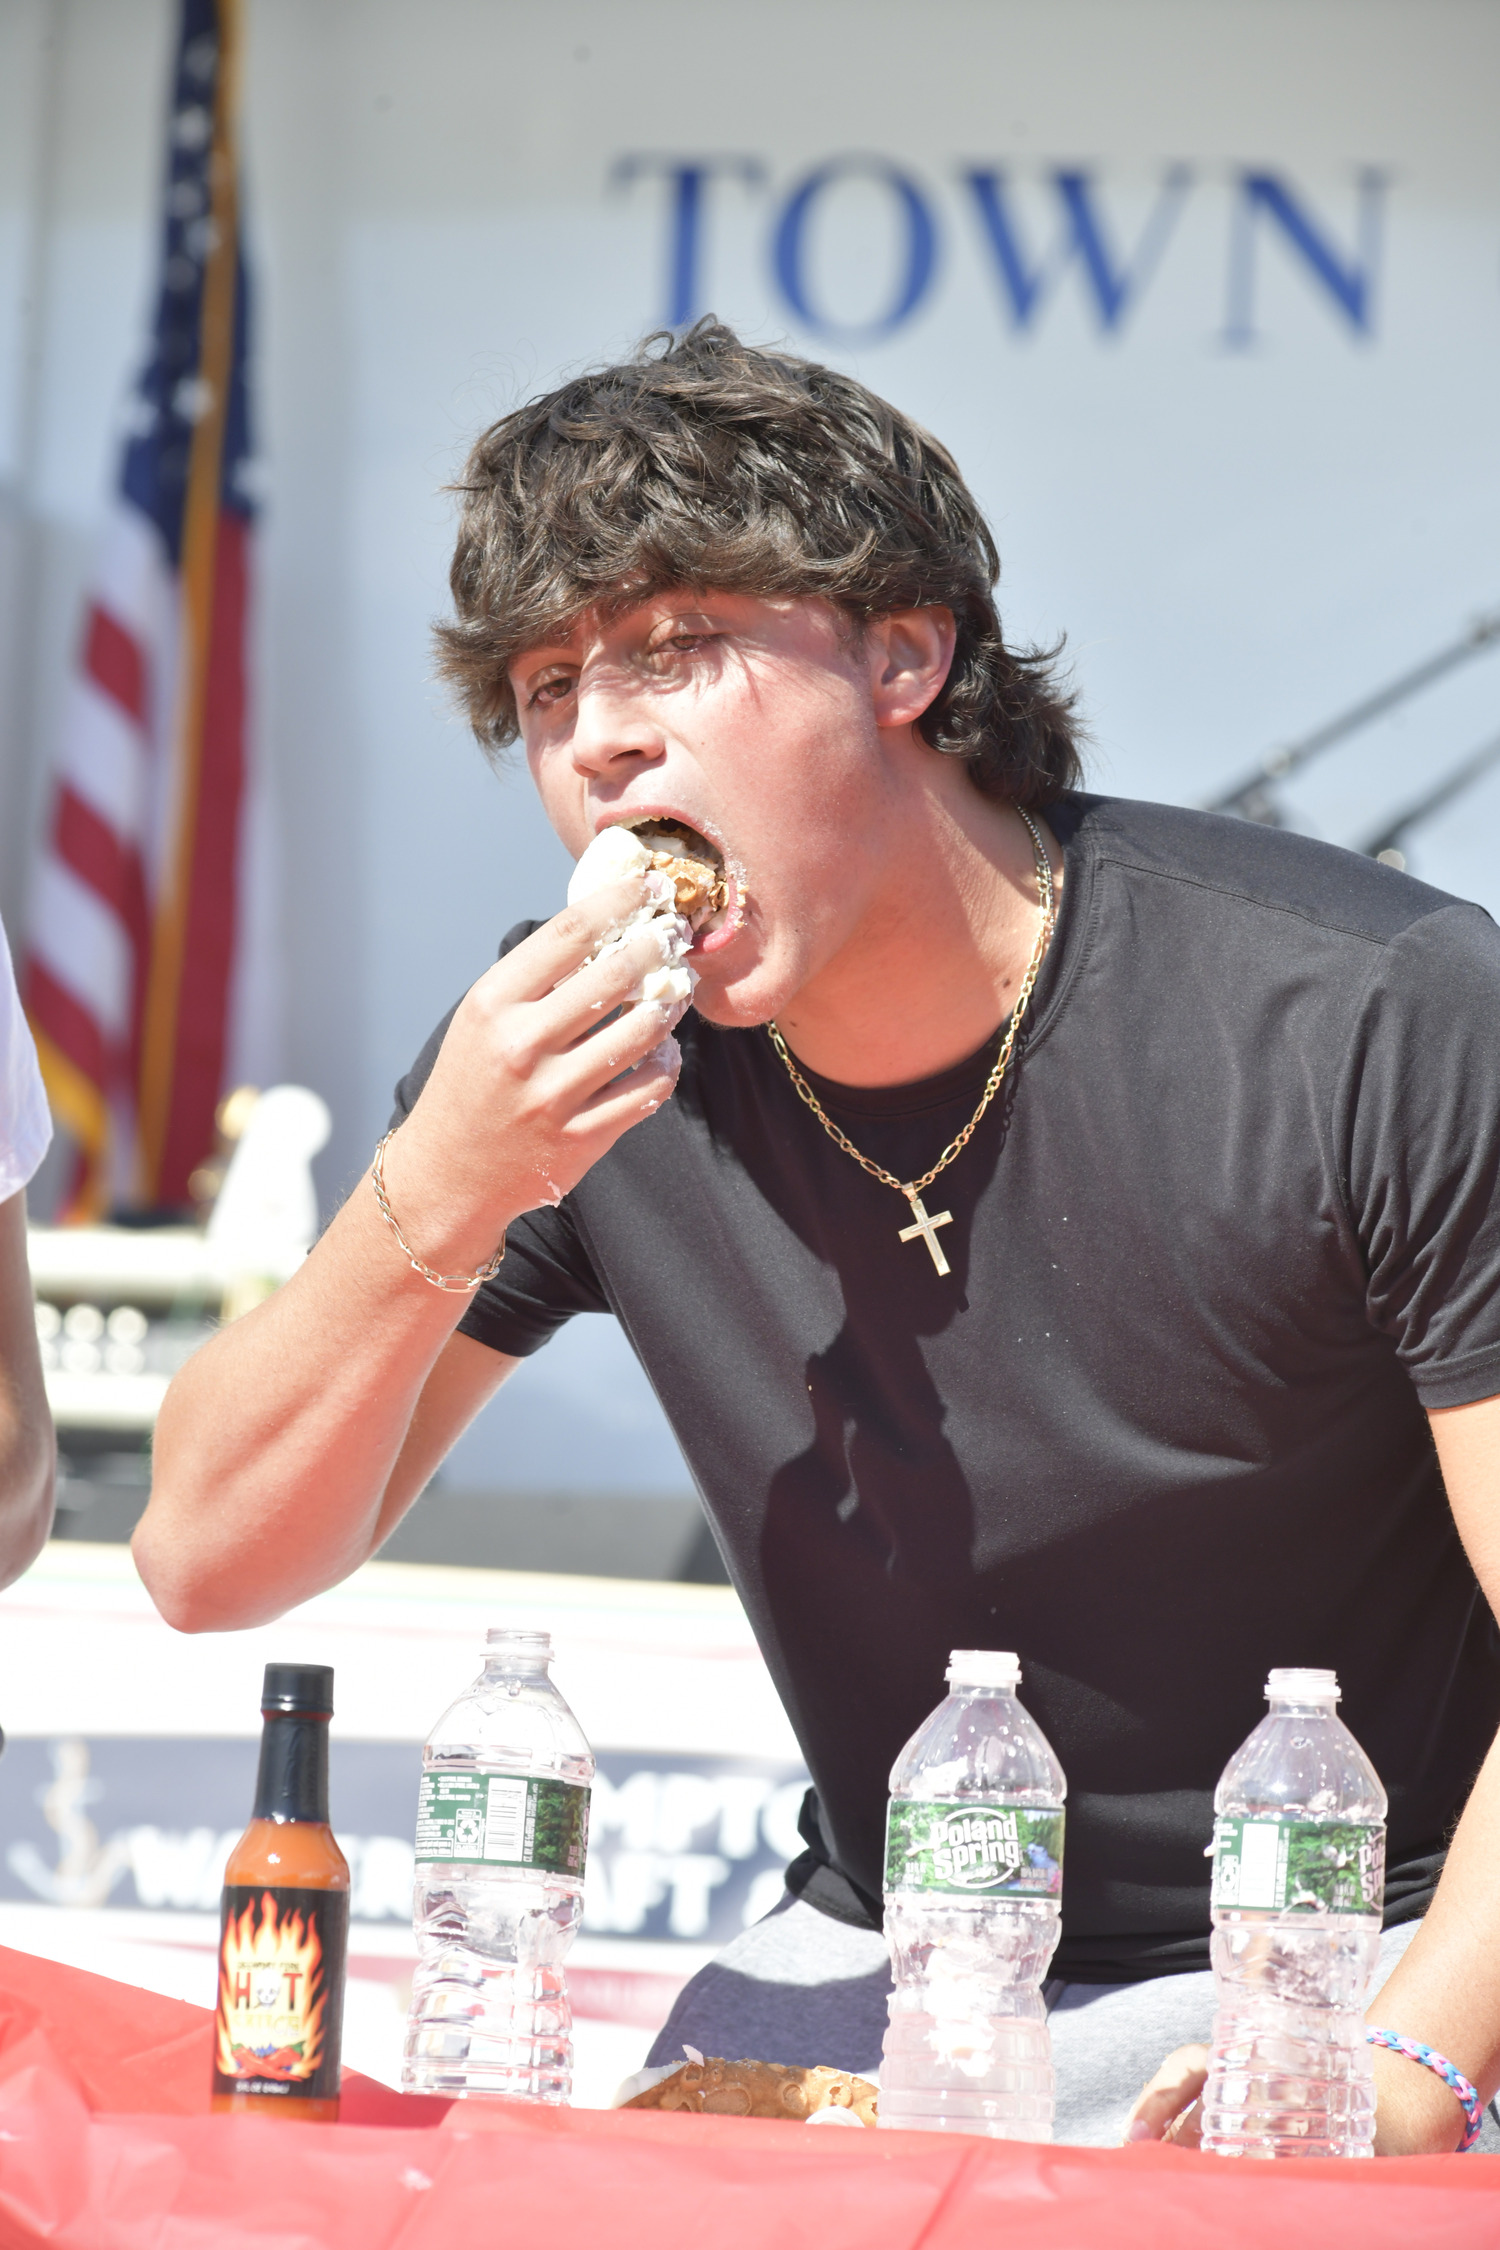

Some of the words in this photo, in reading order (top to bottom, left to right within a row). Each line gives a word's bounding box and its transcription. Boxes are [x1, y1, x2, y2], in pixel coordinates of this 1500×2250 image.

[608, 148, 1397, 348] TOWN
[929, 1811, 1019, 1851] Poland
[932, 1838, 1021, 1880] Spring
[234, 1970, 304, 2010] HOT
